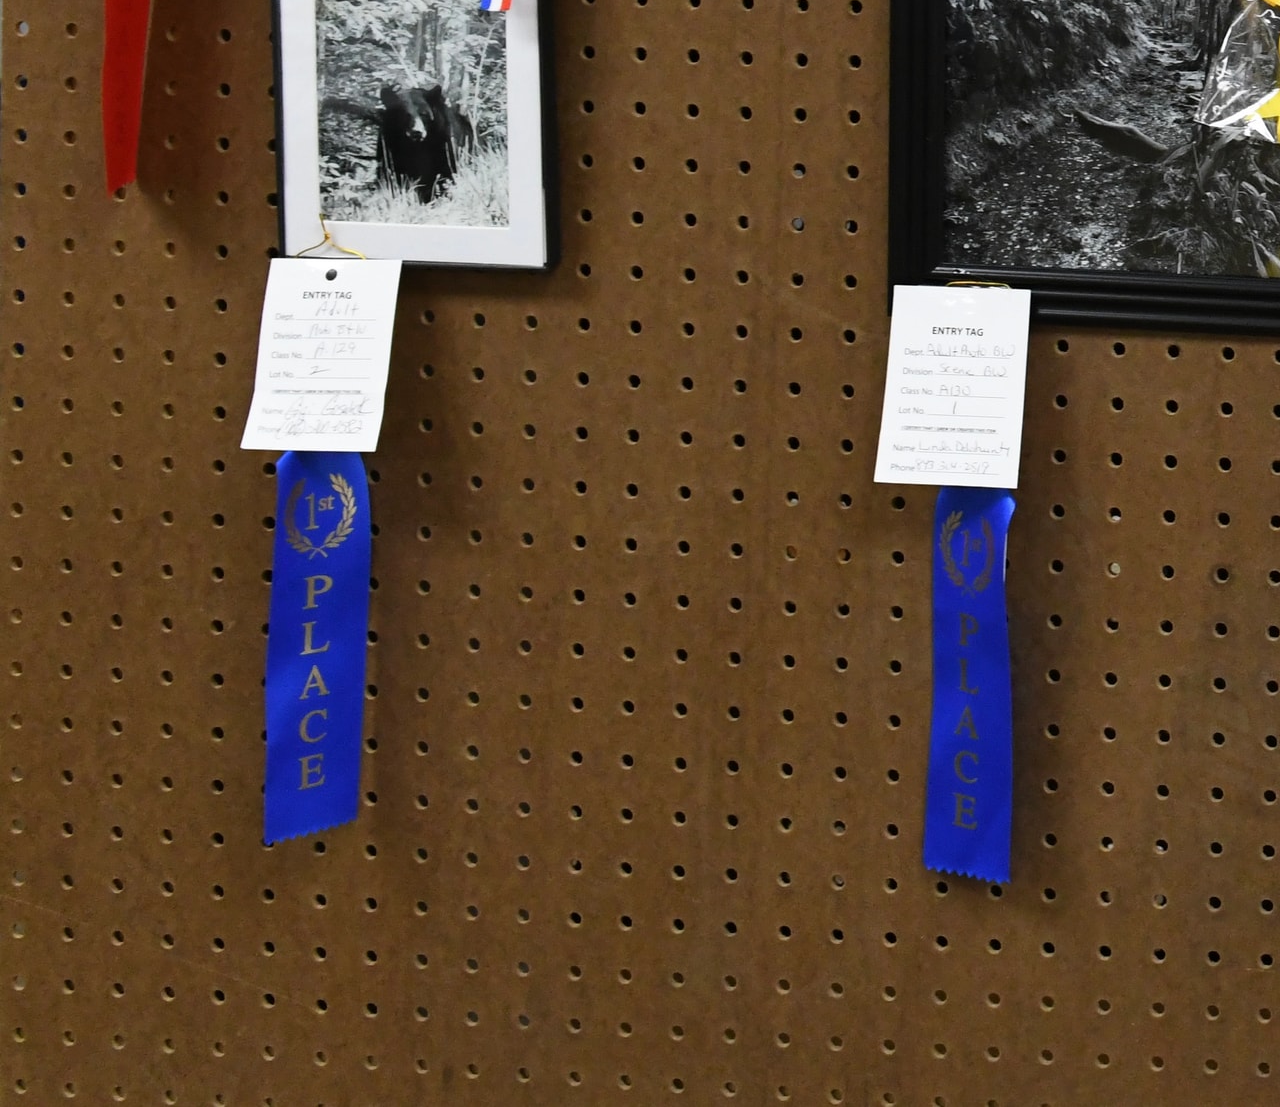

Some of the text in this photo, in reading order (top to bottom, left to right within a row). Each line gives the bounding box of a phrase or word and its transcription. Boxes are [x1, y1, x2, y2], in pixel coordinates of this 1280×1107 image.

[302, 291, 352, 300] ENTRY TAG
[932, 326, 984, 336] ENTRY TAG
[304, 492, 336, 532] 1st
[298, 574, 334, 791] PLACE
[952, 612, 980, 831] PLACE
